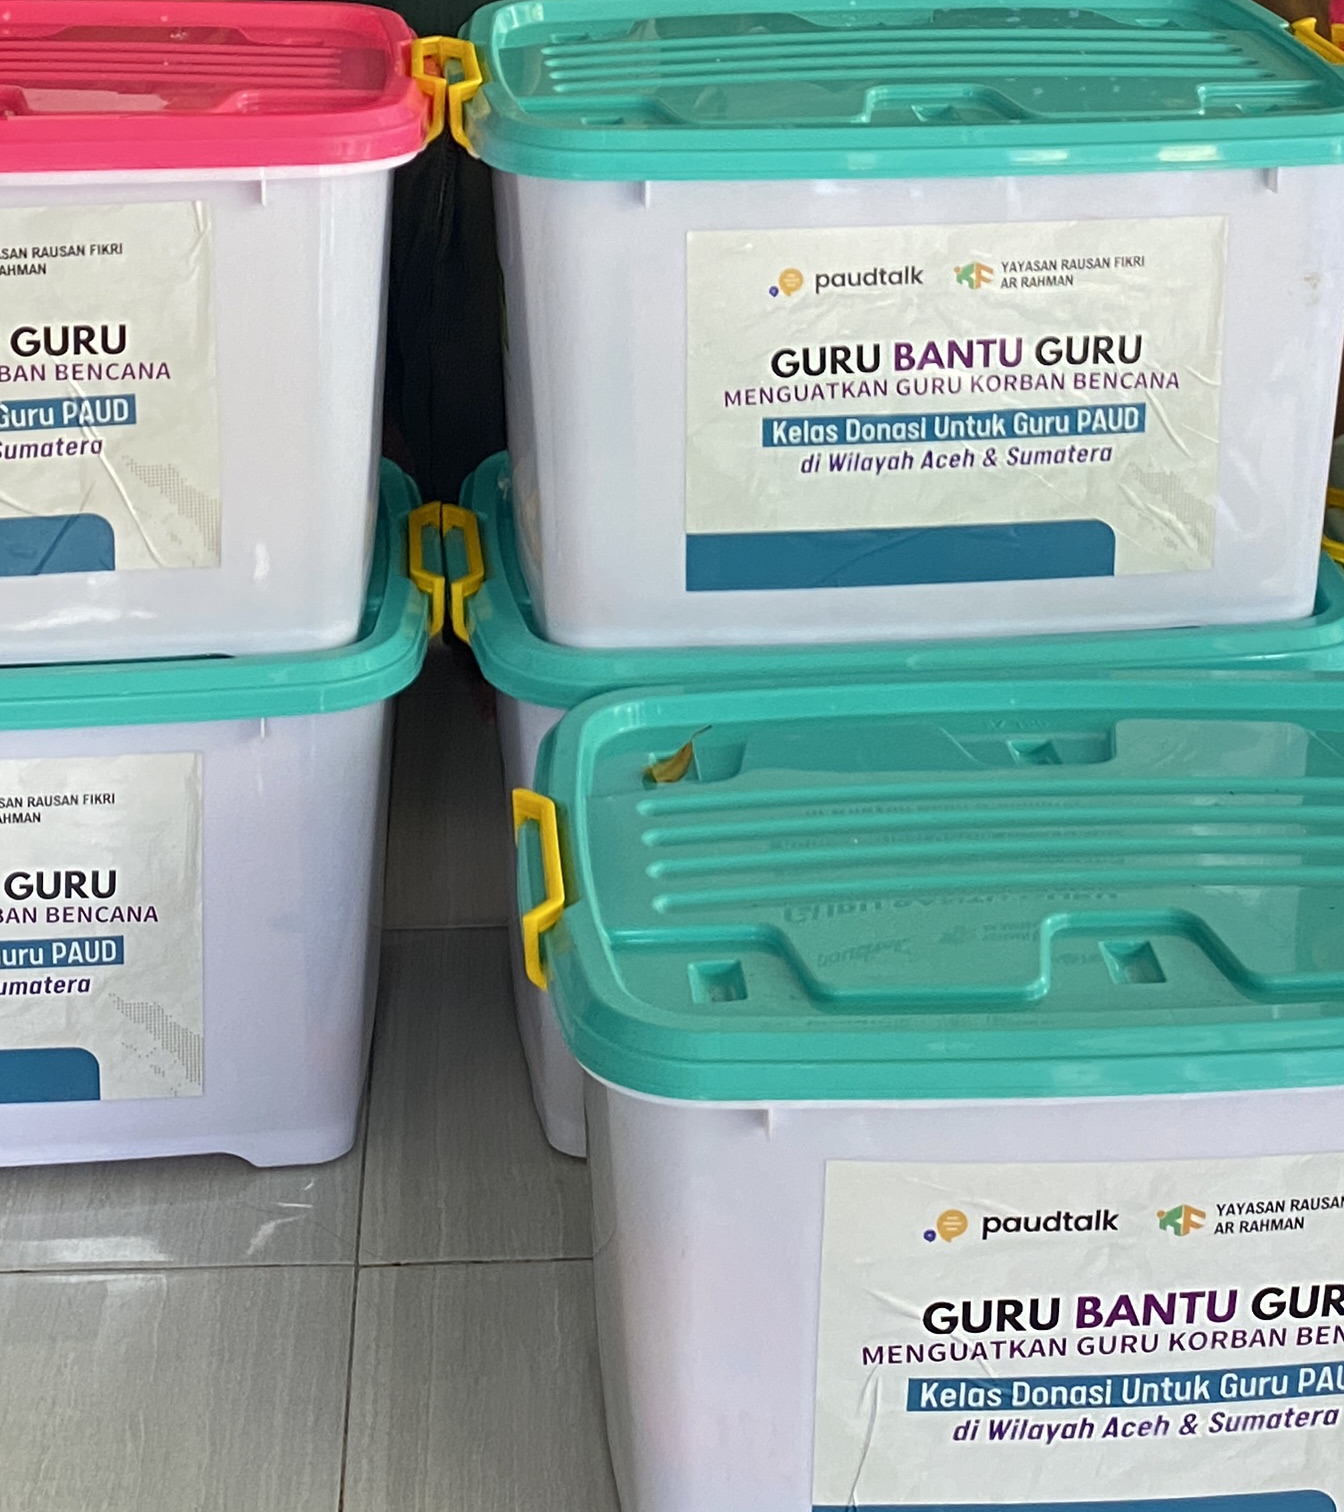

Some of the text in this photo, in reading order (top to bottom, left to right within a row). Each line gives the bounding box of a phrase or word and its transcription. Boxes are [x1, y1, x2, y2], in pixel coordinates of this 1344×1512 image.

[815, 266, 924, 294] paudtalk
[10, 324, 127, 357] GURU
[771, 334, 1142, 378] GURU BANTU GURU
[55, 362, 170, 381] BENCANA
[4, 869, 117, 901] GURU
[982, 1209, 1119, 1239] paudtalk
[1214, 1216, 1304, 1235] AR RAHMAN
[1217, 1202, 1284, 1217] YAYASAN
[922, 1298, 1060, 1334] GURU
[1075, 1290, 1237, 1328] BANTU
[862, 1337, 1068, 1365] MENGUATKAN
[1077, 1334, 1159, 1357] GURU
[1169, 1328, 1286, 1352] KORBAN
[920, 1379, 1002, 1408] Kelas
[1012, 1376, 1112, 1407] Donasi
[1122, 1373, 1209, 1403] Untuk
[1220, 1371, 1289, 1400] Guru
[953, 1406, 1339, 1444] di Wilayah Aceh & Sumatera
